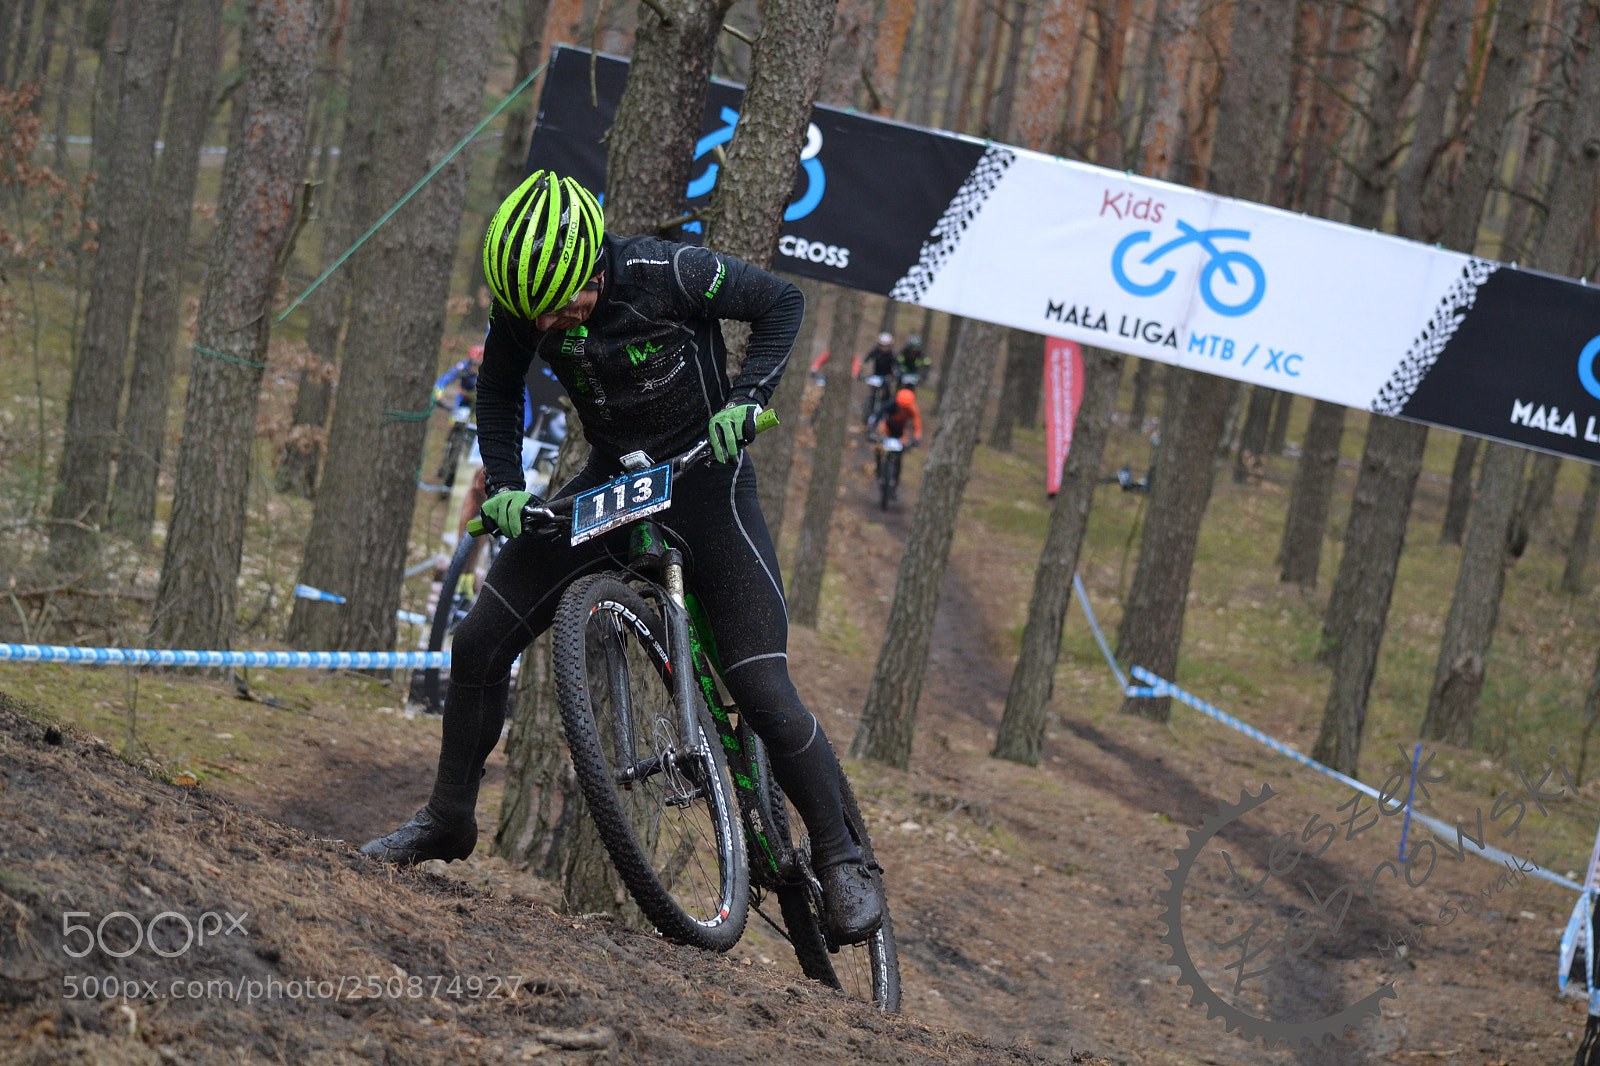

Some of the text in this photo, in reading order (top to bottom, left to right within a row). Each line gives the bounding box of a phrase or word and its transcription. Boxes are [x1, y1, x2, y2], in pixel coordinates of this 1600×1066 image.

[1100, 189, 1166, 223] Kids
[778, 235, 850, 269] CROSS
[1045, 299, 1305, 378] MAŁA LIGA MTB / XC
[1510, 398, 1600, 443] MAŁA L
[592, 477, 653, 519] 113
